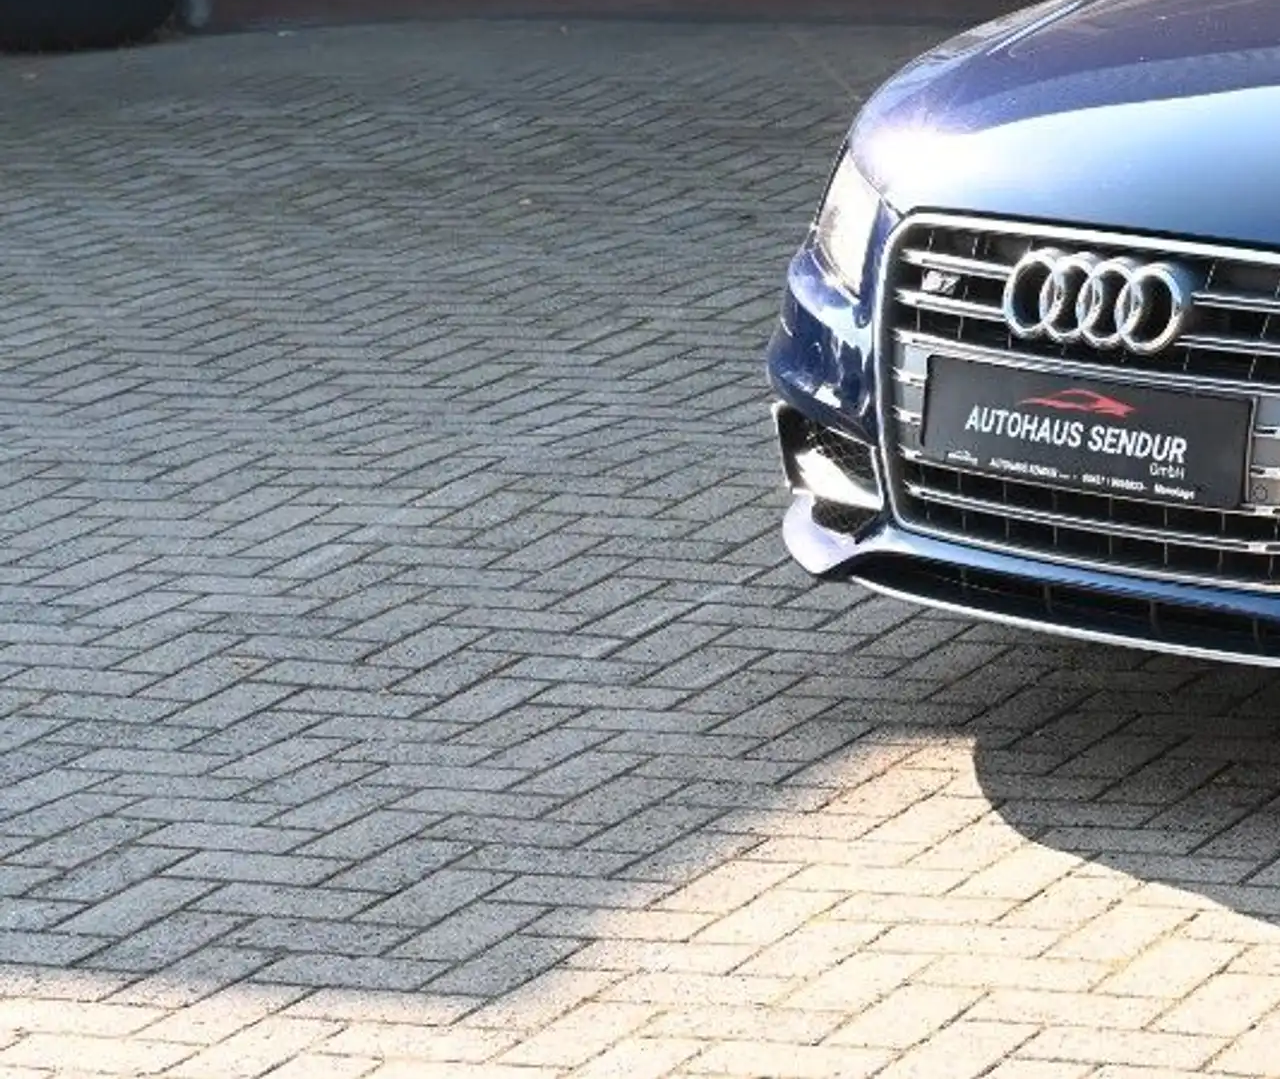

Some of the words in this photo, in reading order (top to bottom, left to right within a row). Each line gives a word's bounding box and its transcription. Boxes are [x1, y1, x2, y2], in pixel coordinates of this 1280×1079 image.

[964, 405, 1084, 448] AUTOHAUS
[1087, 424, 1188, 464] SENDUR
[1149, 462, 1185, 480] GmbH
